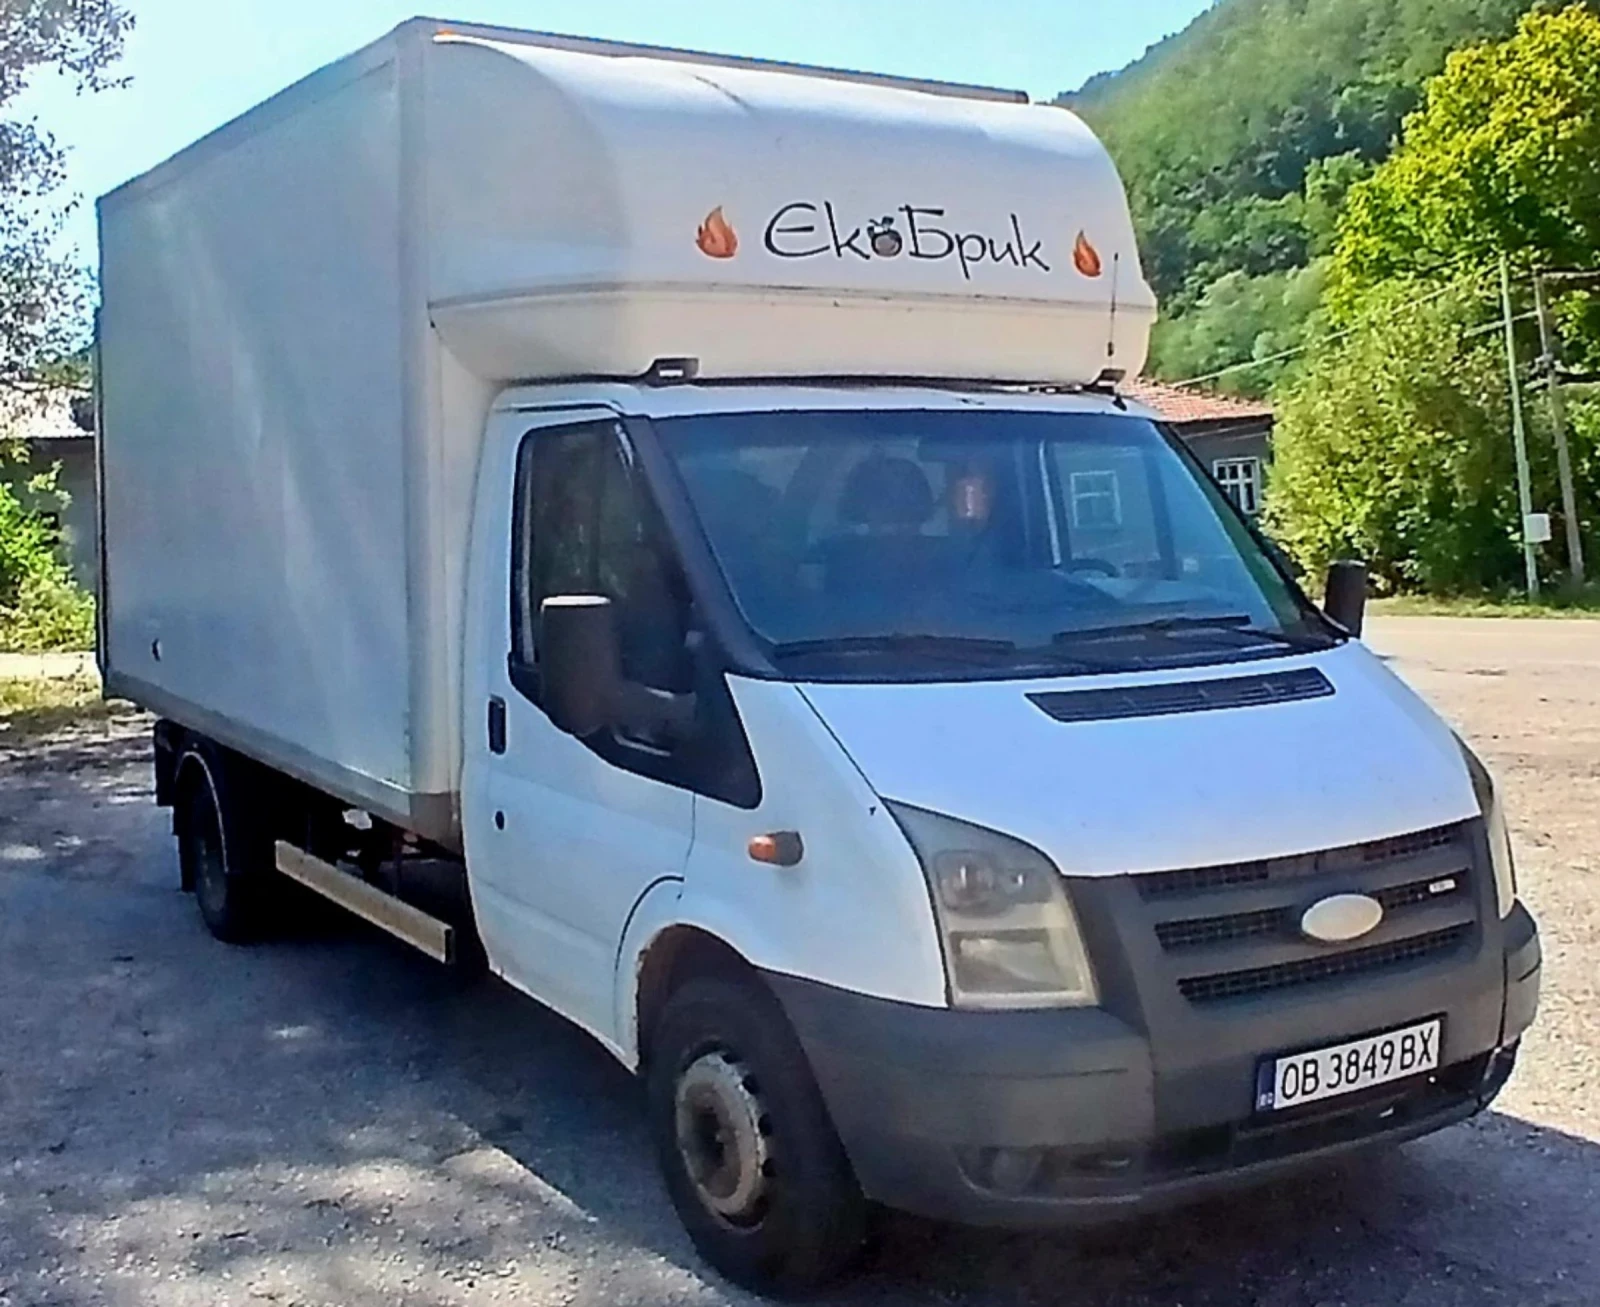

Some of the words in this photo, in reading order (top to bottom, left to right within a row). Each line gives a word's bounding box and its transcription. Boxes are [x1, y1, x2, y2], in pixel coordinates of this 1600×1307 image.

[1281, 1058, 1320, 1100] OB
[1326, 1040, 1395, 1090] 3849
[1400, 1026, 1434, 1071] BX
